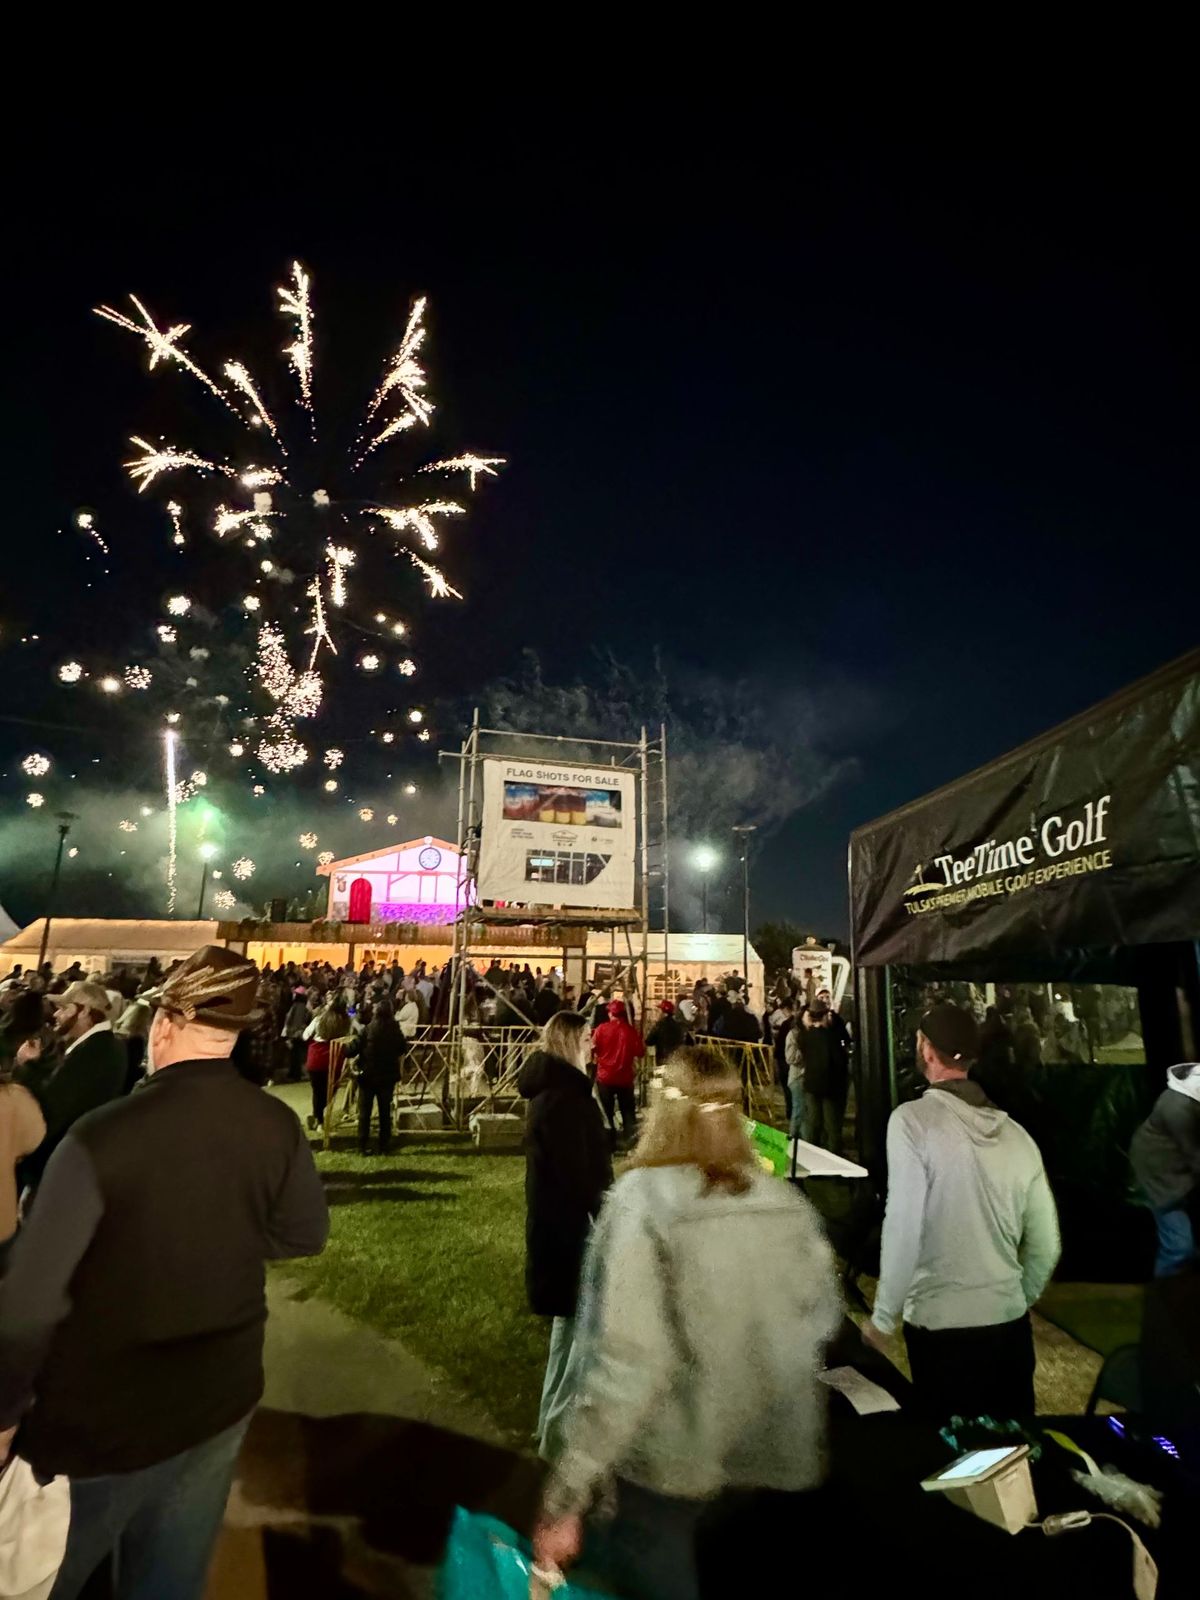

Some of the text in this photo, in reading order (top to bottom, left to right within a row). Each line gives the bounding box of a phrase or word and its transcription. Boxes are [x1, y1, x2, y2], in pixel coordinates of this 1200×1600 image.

[506, 767, 619, 786] FLAG SHOTS FOR SALE
[933, 794, 1111, 888] TeeTime Golf
[966, 879, 1005, 902] MOBILE
[1004, 871, 1034, 893] GOLF
[1034, 849, 1113, 885] EXPERIENCE
